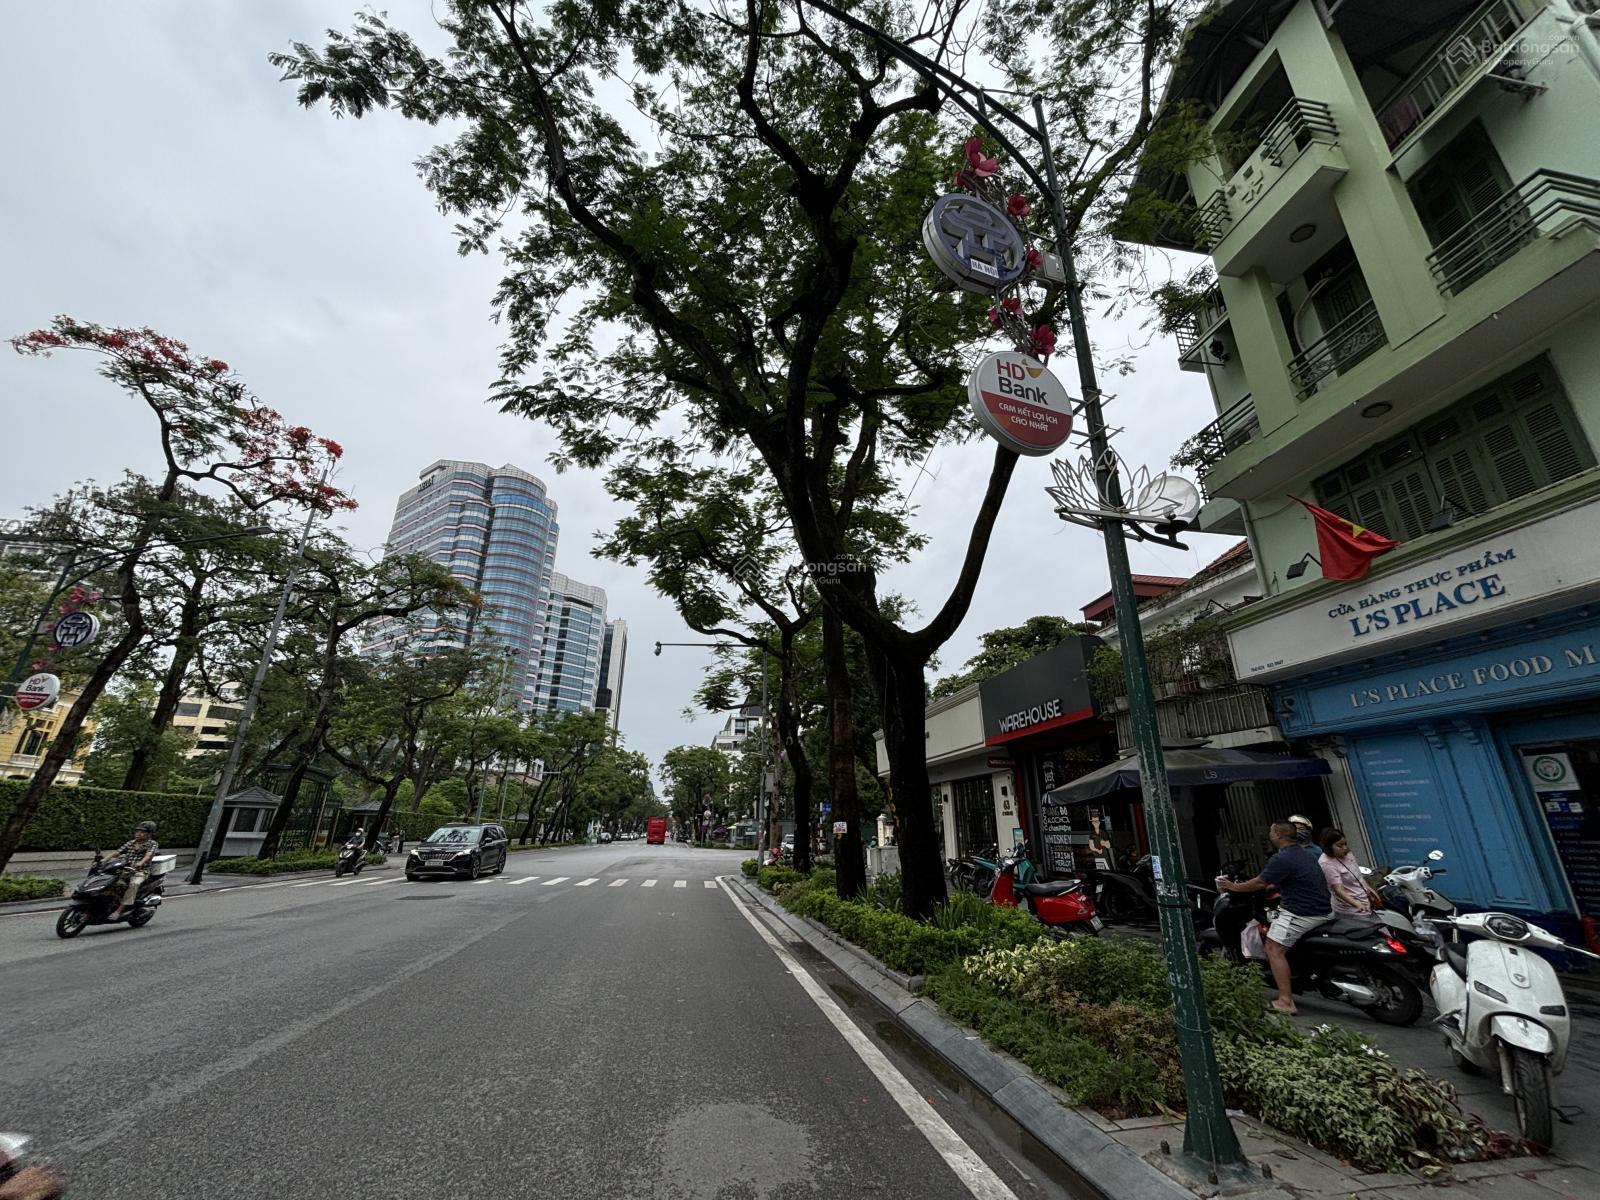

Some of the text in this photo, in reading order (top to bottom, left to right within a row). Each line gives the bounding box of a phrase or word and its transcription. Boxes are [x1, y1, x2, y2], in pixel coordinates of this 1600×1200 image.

[996, 358, 1026, 381] HD
[998, 376, 1049, 405] Bank
[1010, 415, 1028, 426] CAO
[1017, 406, 1031, 417] KẾT
[1327, 548, 1517, 619] CỬA HÀNG THỰC PHẨM
[1349, 573, 1507, 637] L'S PLACE
[1350, 688, 1382, 708] L'S
[1386, 671, 1466, 702] PLACE
[1471, 655, 1554, 686] FOOD
[998, 698, 1062, 735] WAREHOUSE
[1045, 834, 1072, 845] WHISKEY
